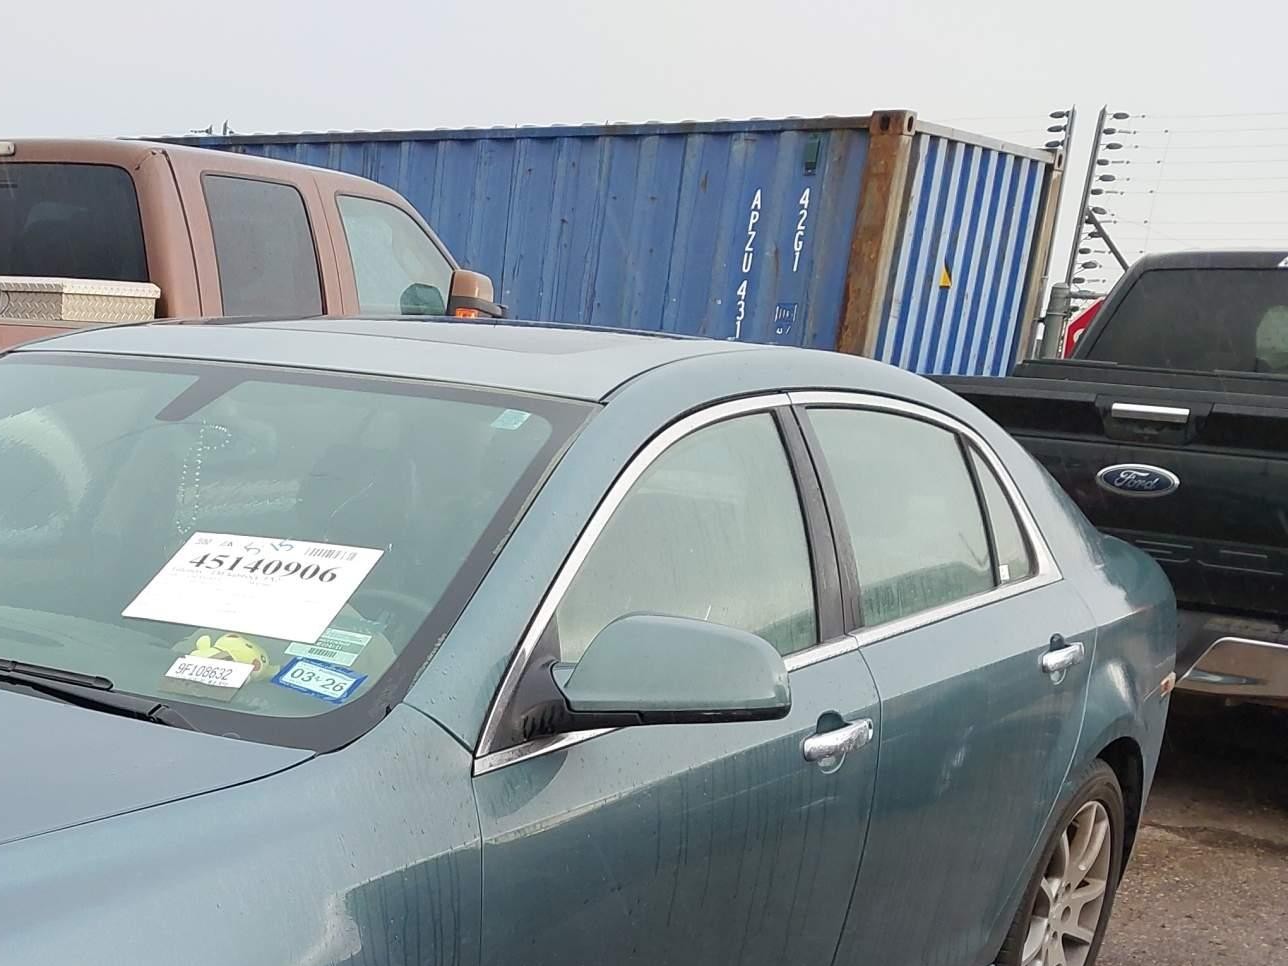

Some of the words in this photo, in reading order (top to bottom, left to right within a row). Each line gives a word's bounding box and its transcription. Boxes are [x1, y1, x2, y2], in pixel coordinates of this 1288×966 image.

[740, 188, 762, 273] APZU
[793, 187, 811, 272] 42G1
[1113, 469, 1161, 491] Ford
[189, 552, 341, 584] 45140906
[175, 662, 233, 681] 9F108632
[290, 668, 316, 682] 03
[320, 678, 348, 692] 26
